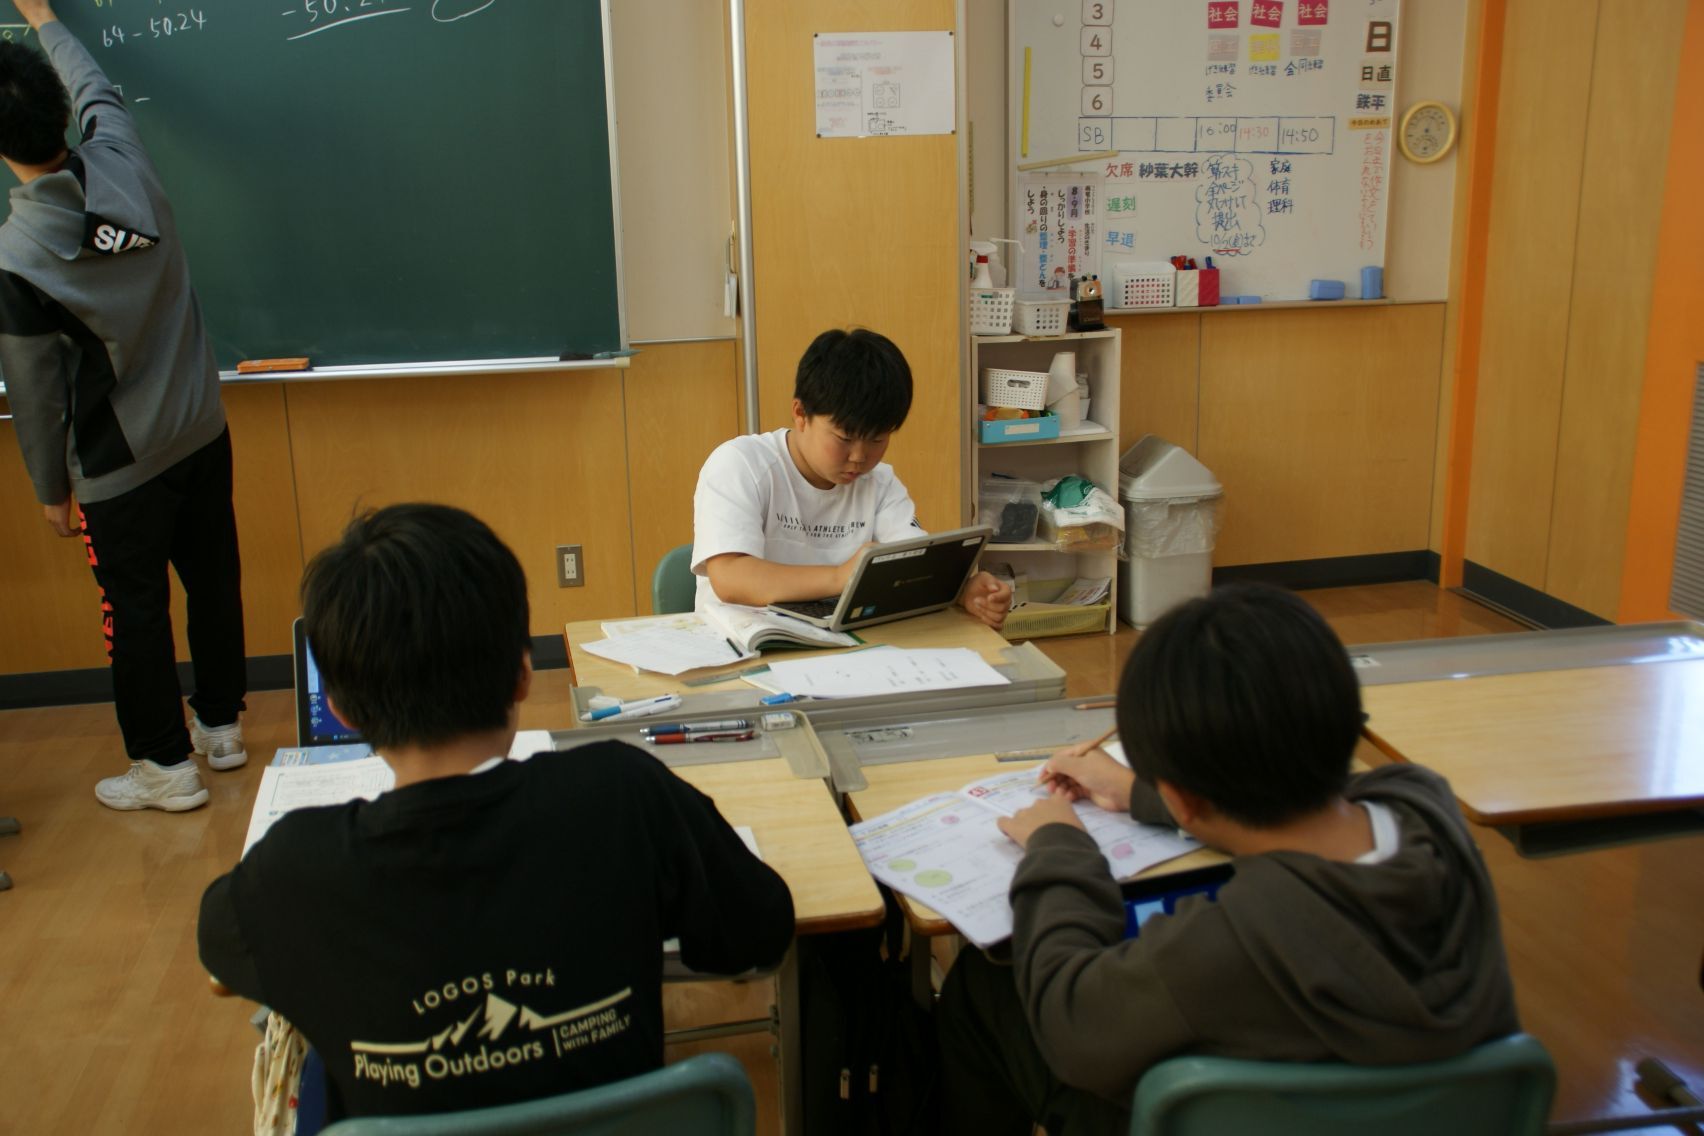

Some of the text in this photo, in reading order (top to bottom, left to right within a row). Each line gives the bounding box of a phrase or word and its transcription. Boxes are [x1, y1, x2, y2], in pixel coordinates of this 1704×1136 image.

[1092, 3, 1104, 20] 3
[1208, 6, 1239, 23] 社会
[1252, 3, 1281, 22] 社会
[1299, 2, 1328, 19] 社会
[1089, 33, 1103, 51] 4
[1366, 21, 1392, 53] 日
[1092, 63, 1105, 80] 5
[1361, 64, 1393, 83] 日直
[1091, 94, 1103, 111] 6
[1083, 126, 1105, 145] SB
[1199, 121, 1237, 139] 16:00
[1281, 127, 1319, 145] 14:50
[1105, 163, 1134, 179] 欠席
[1270, 158, 1293, 175] 家庭
[1266, 177, 1292, 196] 体育
[1106, 196, 1136, 213] 遅刻
[1266, 198, 1294, 216] 理科
[1105, 231, 1134, 248] 早退
[412, 967, 556, 1016] LOGOS Park
[559, 1007, 618, 1039] CAMPING
[562, 1014, 632, 1051] WITH FAMILY
[354, 1040, 545, 1089] Playing Outdoors
